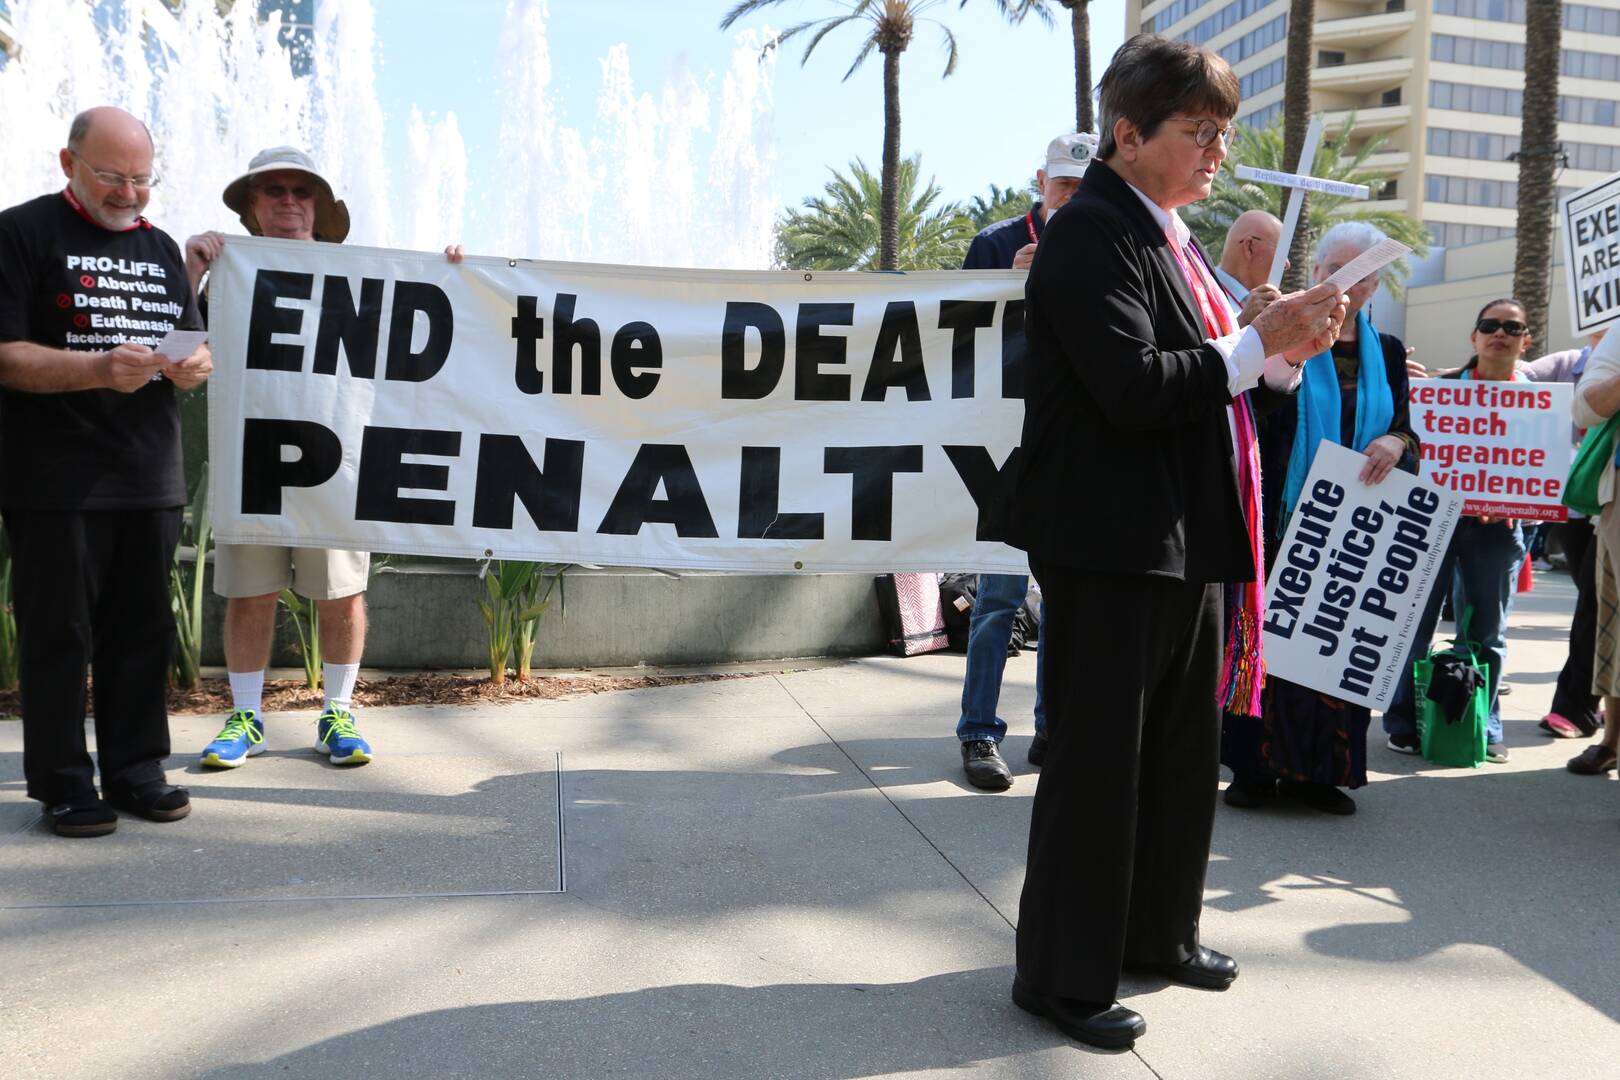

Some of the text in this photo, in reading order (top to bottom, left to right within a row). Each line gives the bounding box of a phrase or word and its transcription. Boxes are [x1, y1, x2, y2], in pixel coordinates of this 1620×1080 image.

[66, 255, 167, 279] PRO-LIFE:
[1581, 243, 1620, 279] ARE
[98, 275, 167, 295] Abortion
[74, 293, 184, 319] Death Penalty
[91, 314, 175, 332] Euthanasia
[246, 269, 454, 383] END
[511, 293, 664, 400] the
[66, 331, 162, 346] facebook.com/c
[1408, 384, 1553, 410] xecutions
[1423, 409, 1507, 437] teach
[1420, 442, 1546, 468] ngeance
[241, 417, 1022, 543] PENALTY
[1431, 469, 1561, 497] violence
[1463, 502, 1559, 519] ww.deathpenalty.org
[1263, 478, 1346, 640] Execute
[1301, 500, 1396, 658] Justice,
[1338, 486, 1441, 697] not People
[1375, 499, 1459, 702] Death Penalty Focus www.deathpenalty.org
